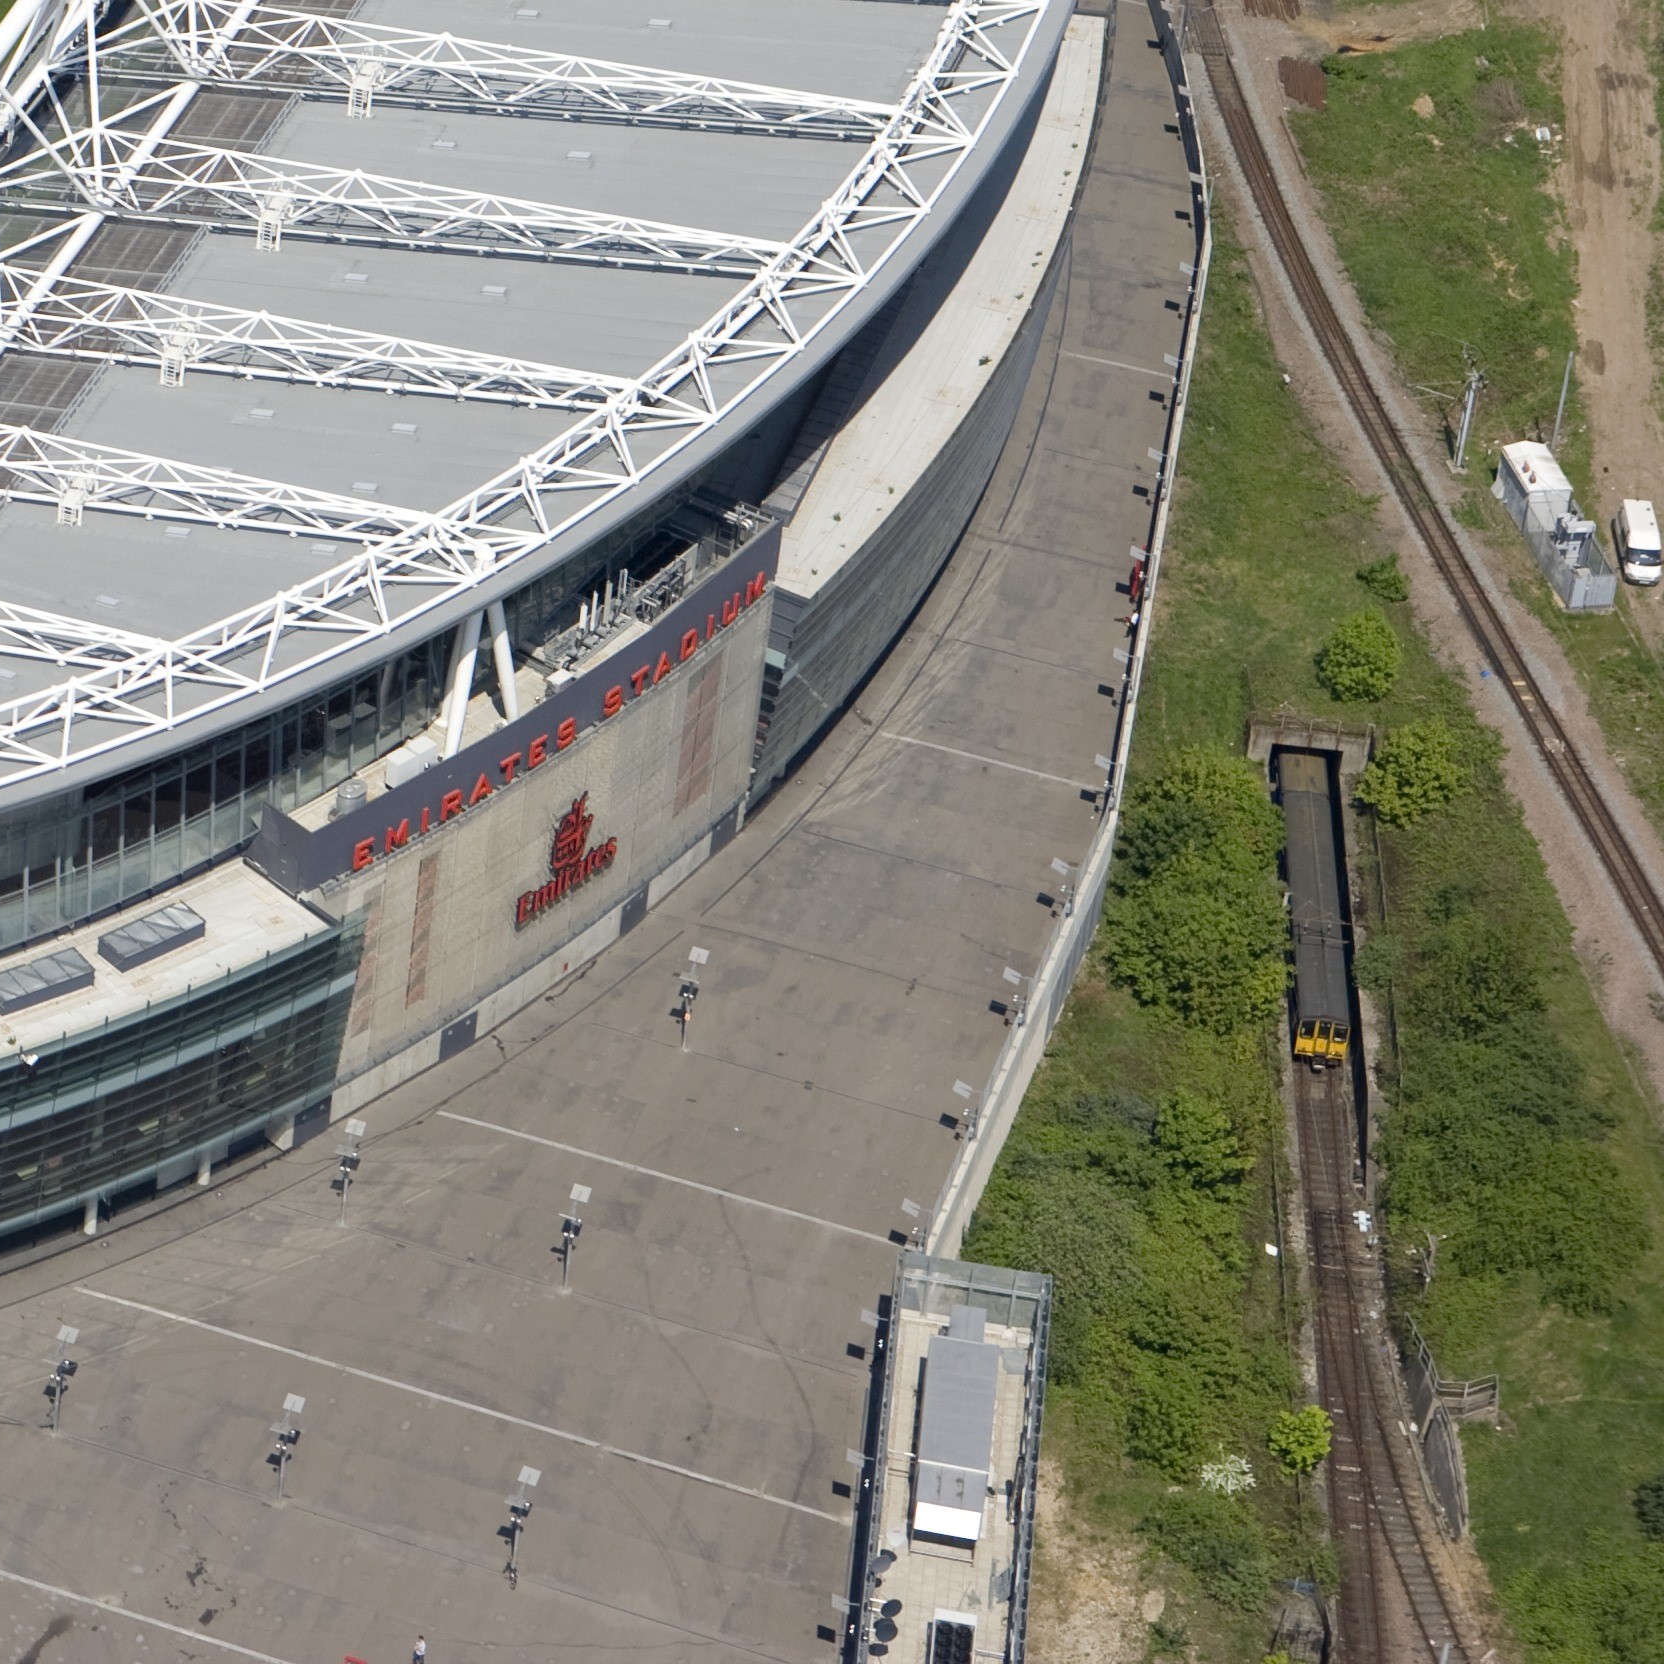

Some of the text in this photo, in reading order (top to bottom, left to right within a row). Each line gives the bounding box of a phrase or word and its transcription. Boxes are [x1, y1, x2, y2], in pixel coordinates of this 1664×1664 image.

[353, 717, 577, 871] EMIRATES
[603, 571, 765, 717] STADIUM
[515, 836, 617, 925] Emirates
